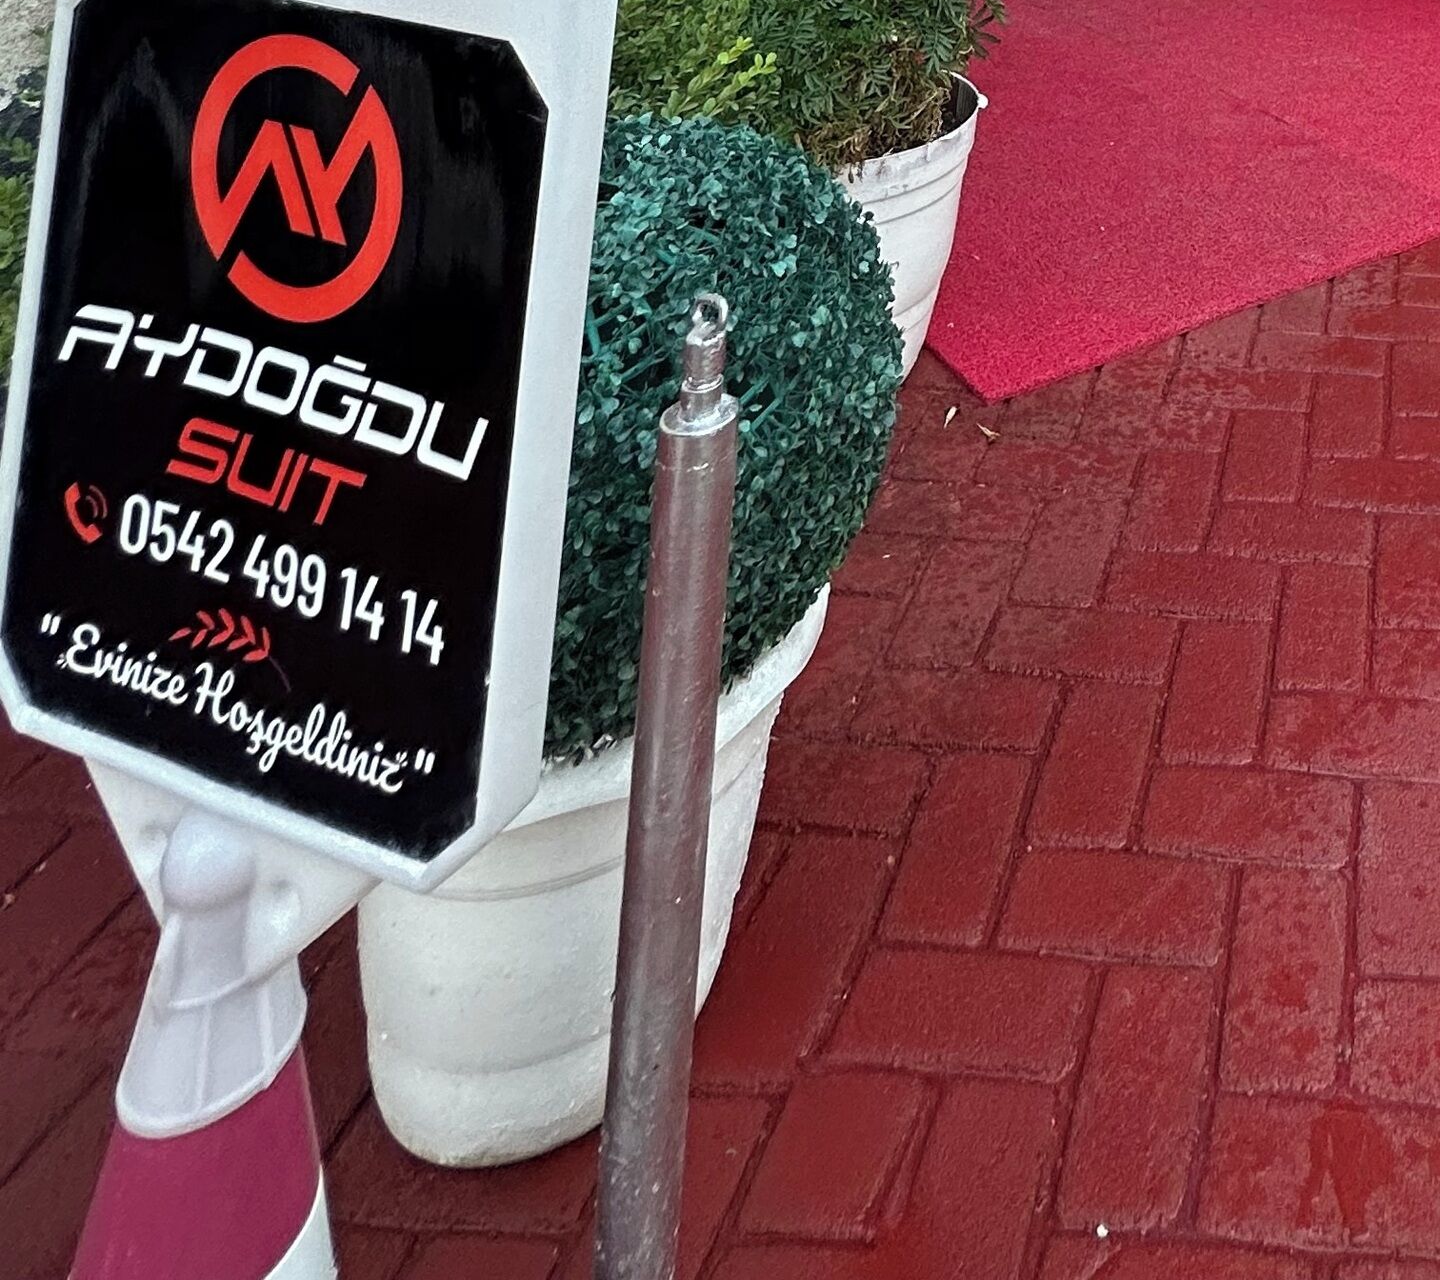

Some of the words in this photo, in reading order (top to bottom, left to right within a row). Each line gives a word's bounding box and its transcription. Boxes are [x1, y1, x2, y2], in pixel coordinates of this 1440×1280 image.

[58, 303, 489, 482] AYDOĞDU
[165, 417, 368, 526] SUIT
[119, 493, 236, 584] 0542
[243, 533, 328, 619] 499
[340, 567, 385, 642] 14
[399, 588, 445, 667] 14
